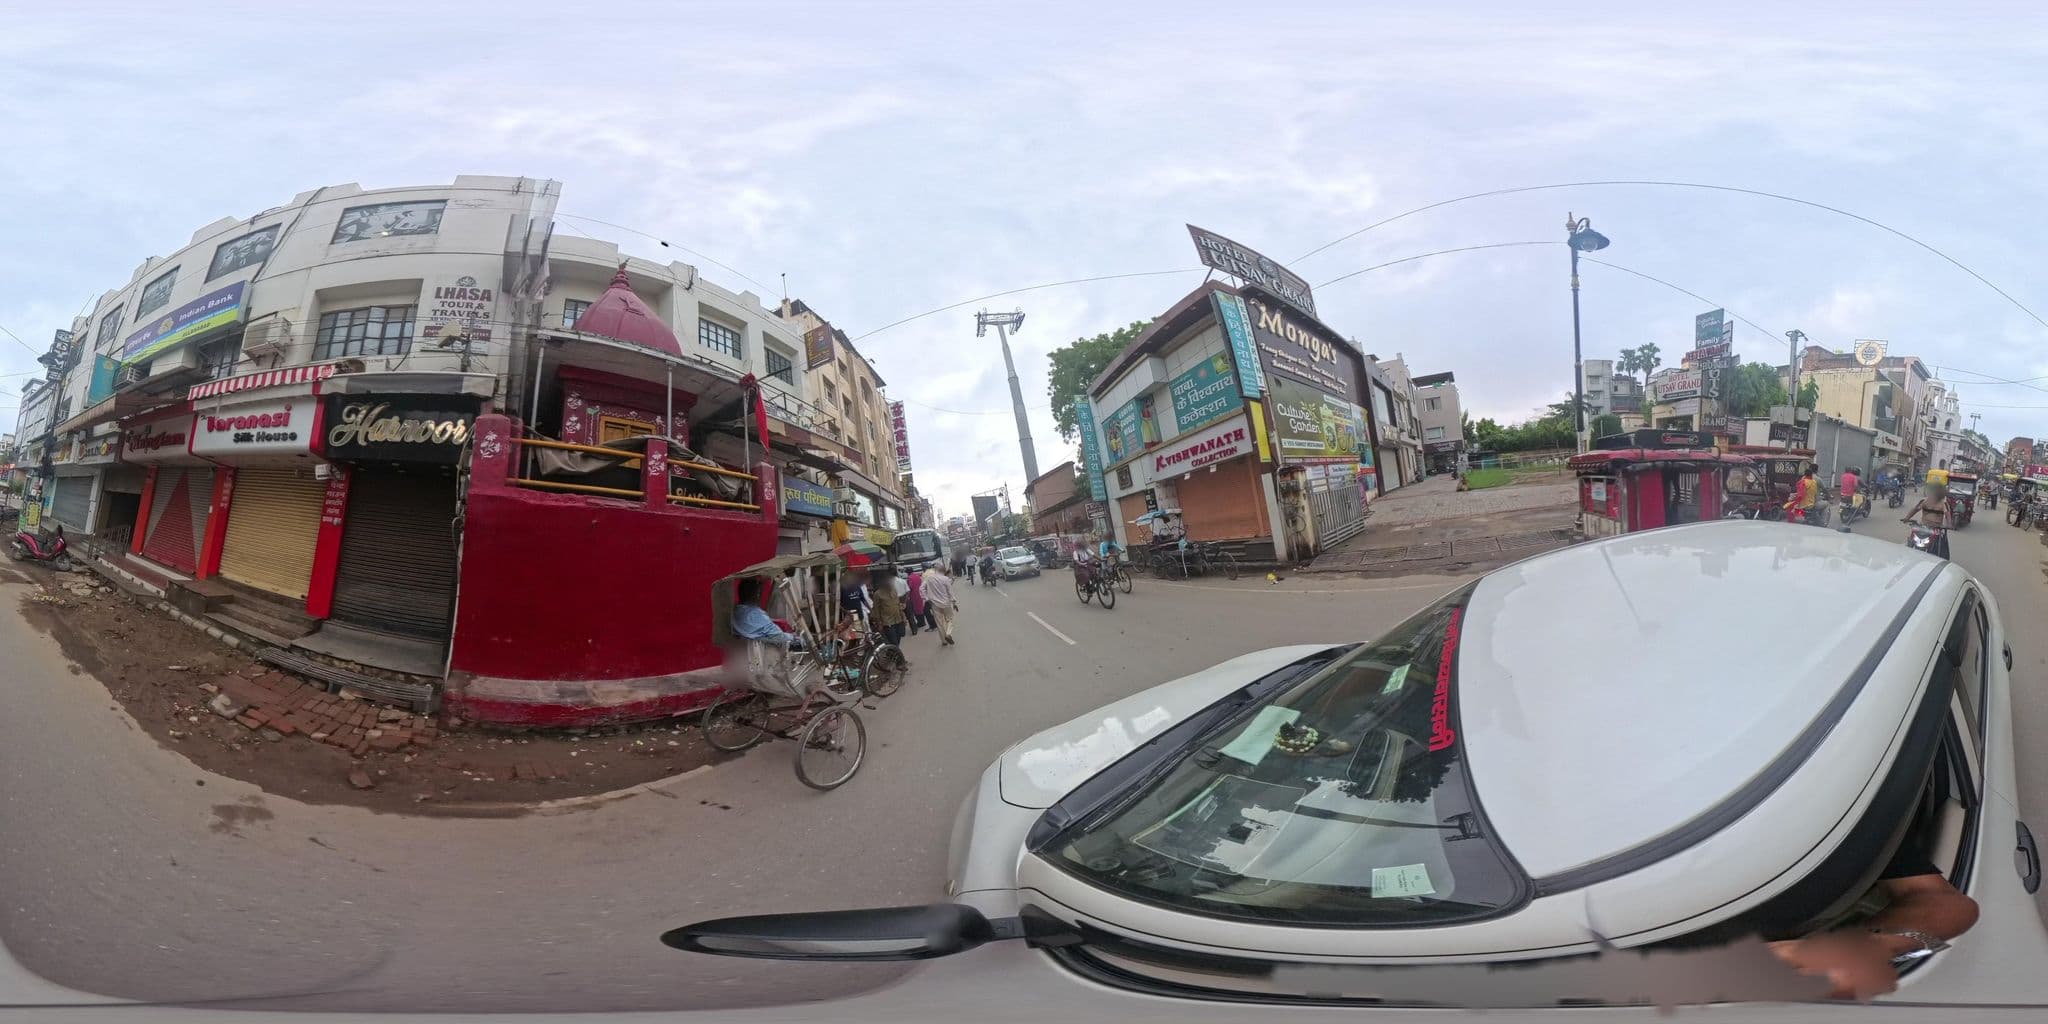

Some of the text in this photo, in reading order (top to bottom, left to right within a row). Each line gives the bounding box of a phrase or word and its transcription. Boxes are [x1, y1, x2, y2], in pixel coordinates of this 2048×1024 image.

[1198, 236, 1250, 264] HOTEL
[1209, 249, 1315, 313] UTSAV GRAND
[435, 287, 492, 302] LHASA
[179, 293, 234, 321] Indian Bank
[432, 309, 490, 319] TRAVELS
[440, 301, 485, 310] TOUR &
[1249, 298, 1337, 365] Monga's
[1697, 337, 1720, 347] Family
[1657, 379, 1701, 393] UTSAV GRAND
[1669, 373, 1689, 382] HOTEL
[1177, 397, 1187, 410] के
[1187, 375, 1234, 405] विश्वनाथ
[207, 403, 292, 432] Varanasi
[1277, 403, 1311, 420] Culture
[329, 401, 467, 447] Harnoor
[1290, 418, 1322, 434] Garden
[233, 431, 298, 443] Silk House
[1191, 446, 1238, 468] COLLECTION
